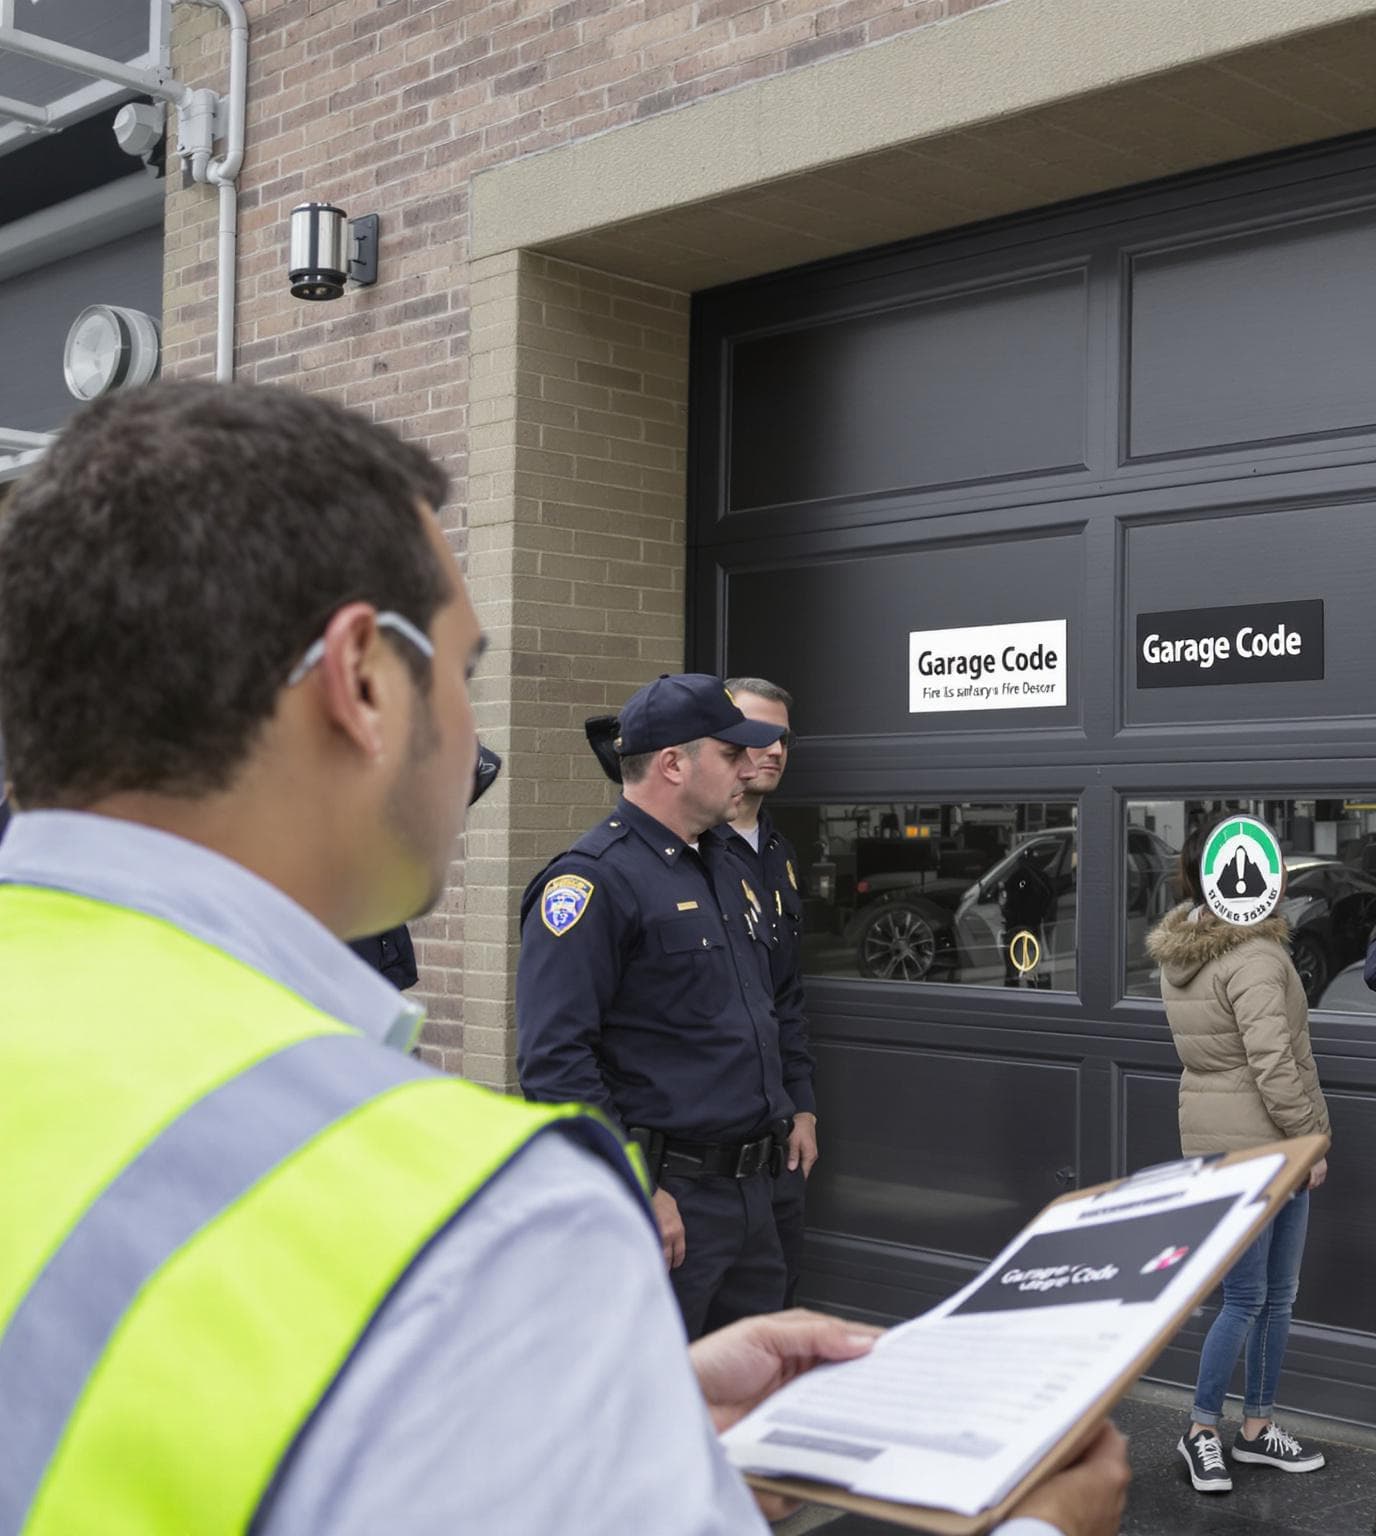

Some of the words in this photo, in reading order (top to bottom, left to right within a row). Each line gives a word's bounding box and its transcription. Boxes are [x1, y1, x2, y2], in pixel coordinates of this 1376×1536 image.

[918, 650, 996, 680] Garage
[1002, 643, 1058, 672] Code
[1143, 633, 1231, 669] Garage
[1236, 623, 1302, 658] Code
